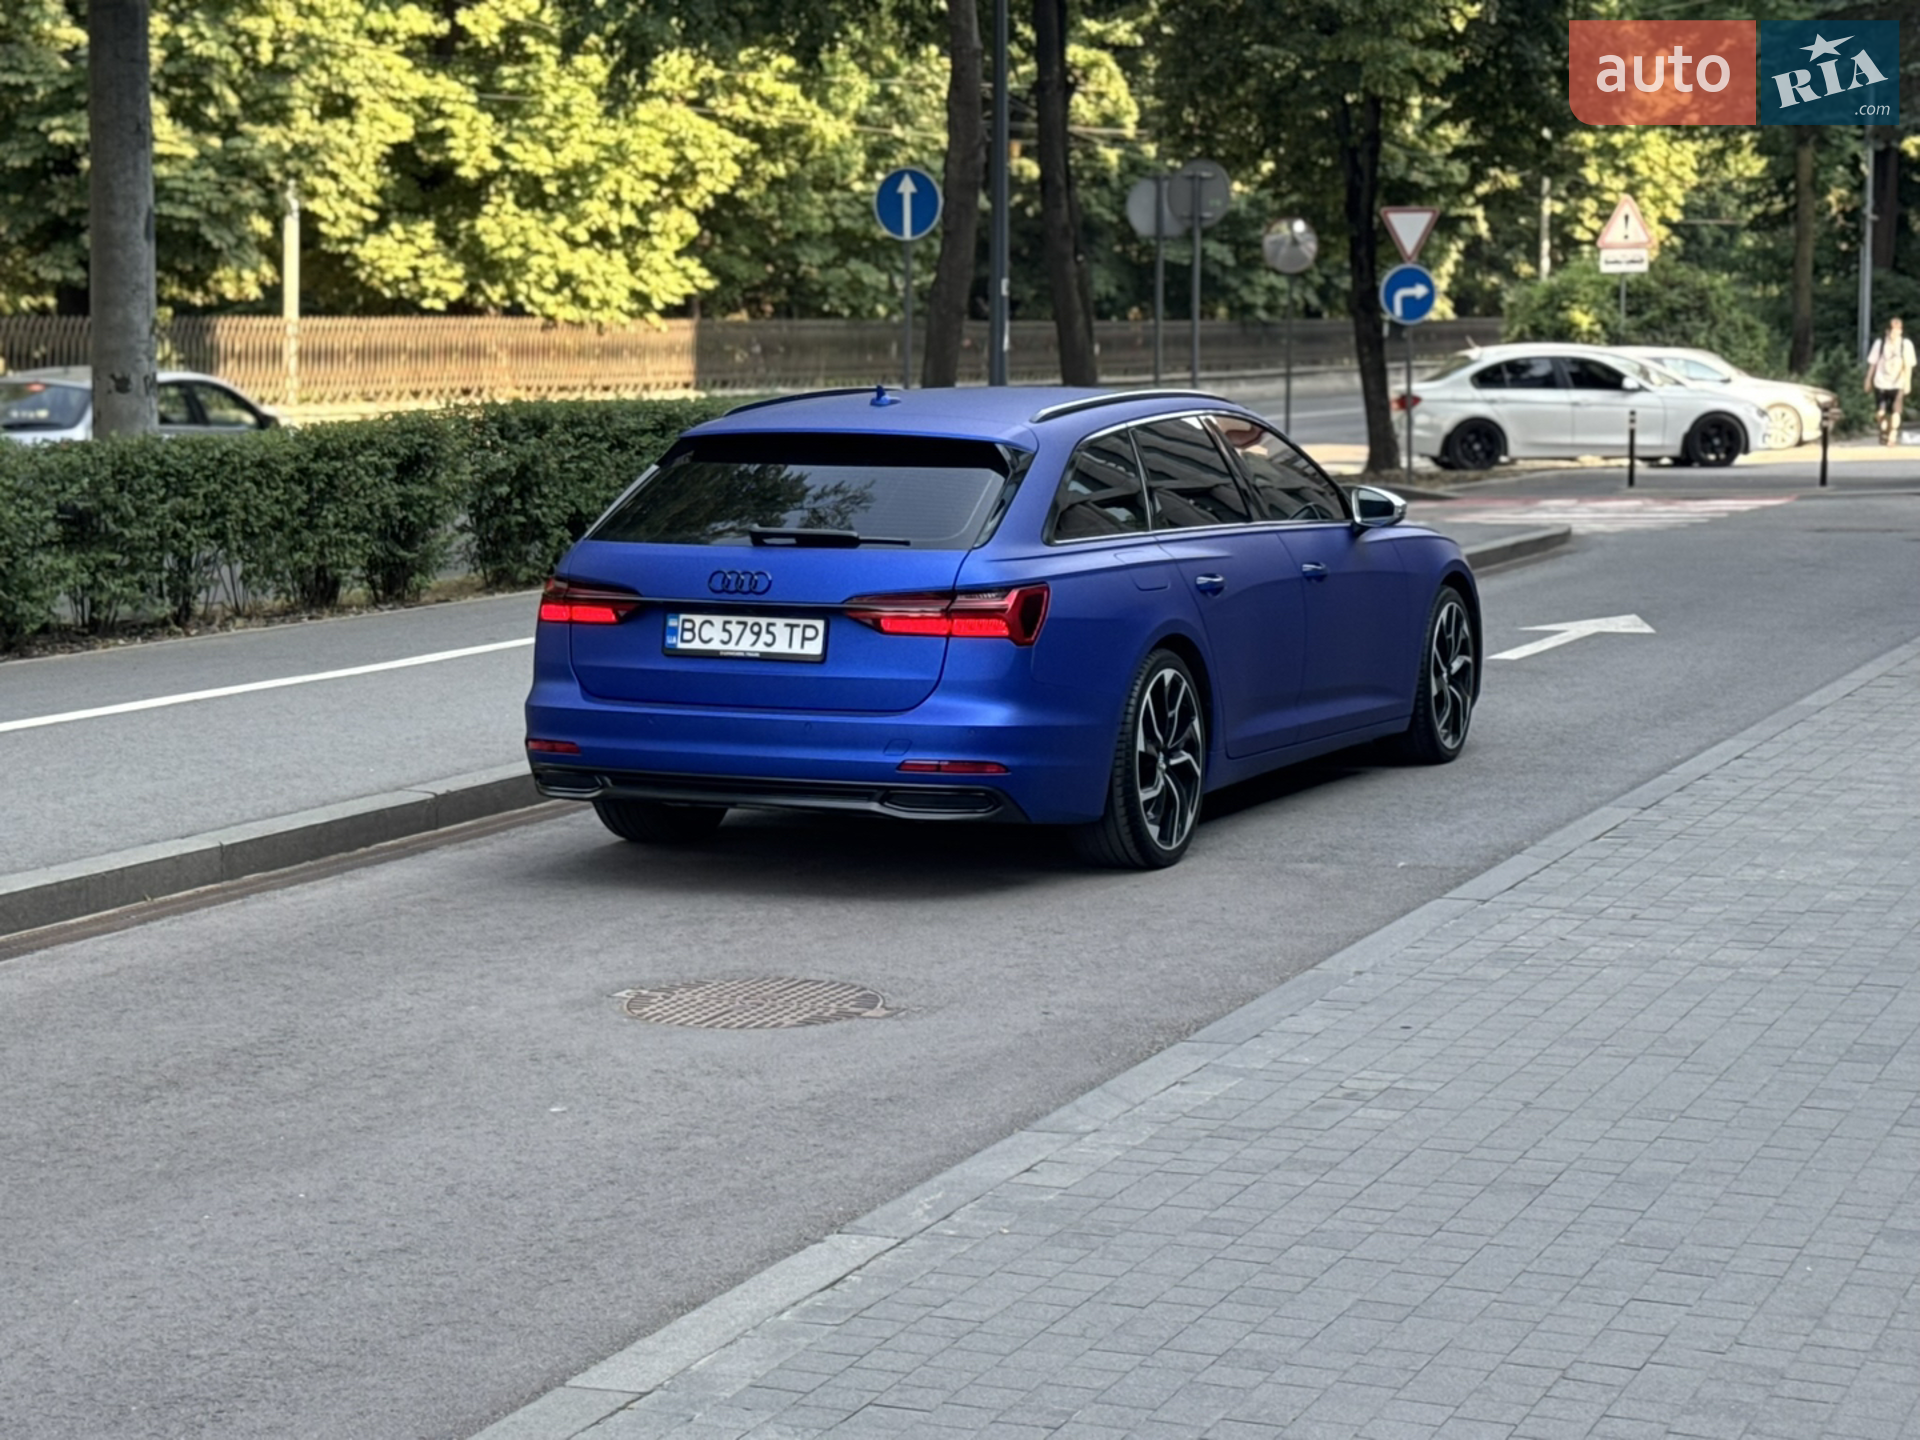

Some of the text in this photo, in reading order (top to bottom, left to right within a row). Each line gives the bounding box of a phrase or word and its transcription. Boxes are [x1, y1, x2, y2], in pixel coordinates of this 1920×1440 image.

[679, 618, 820, 650] BC 5795 TP
